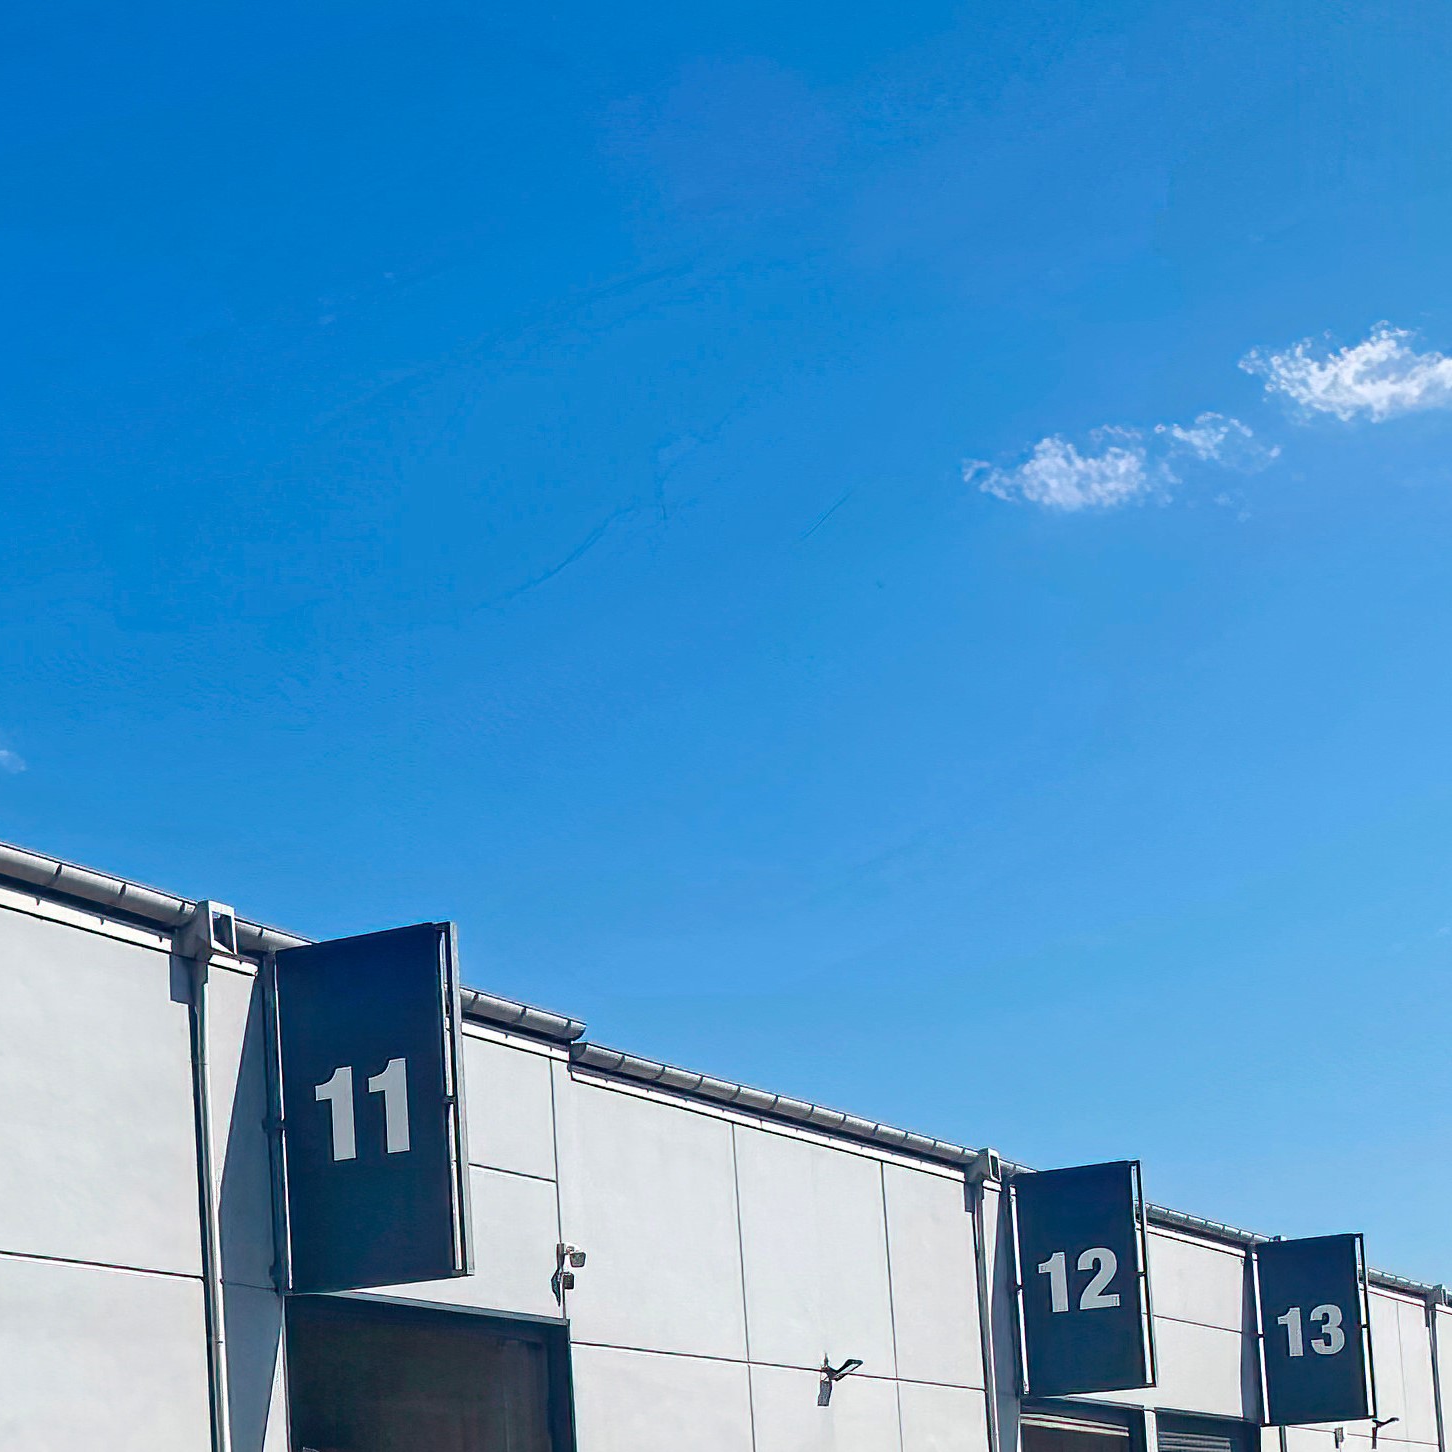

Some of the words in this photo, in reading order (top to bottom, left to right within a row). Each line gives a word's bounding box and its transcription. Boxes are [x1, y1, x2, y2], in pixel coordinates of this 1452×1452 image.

[314, 1057, 410, 1161] 11
[1038, 1247, 1121, 1313] 12
[1277, 1304, 1345, 1357] 13
